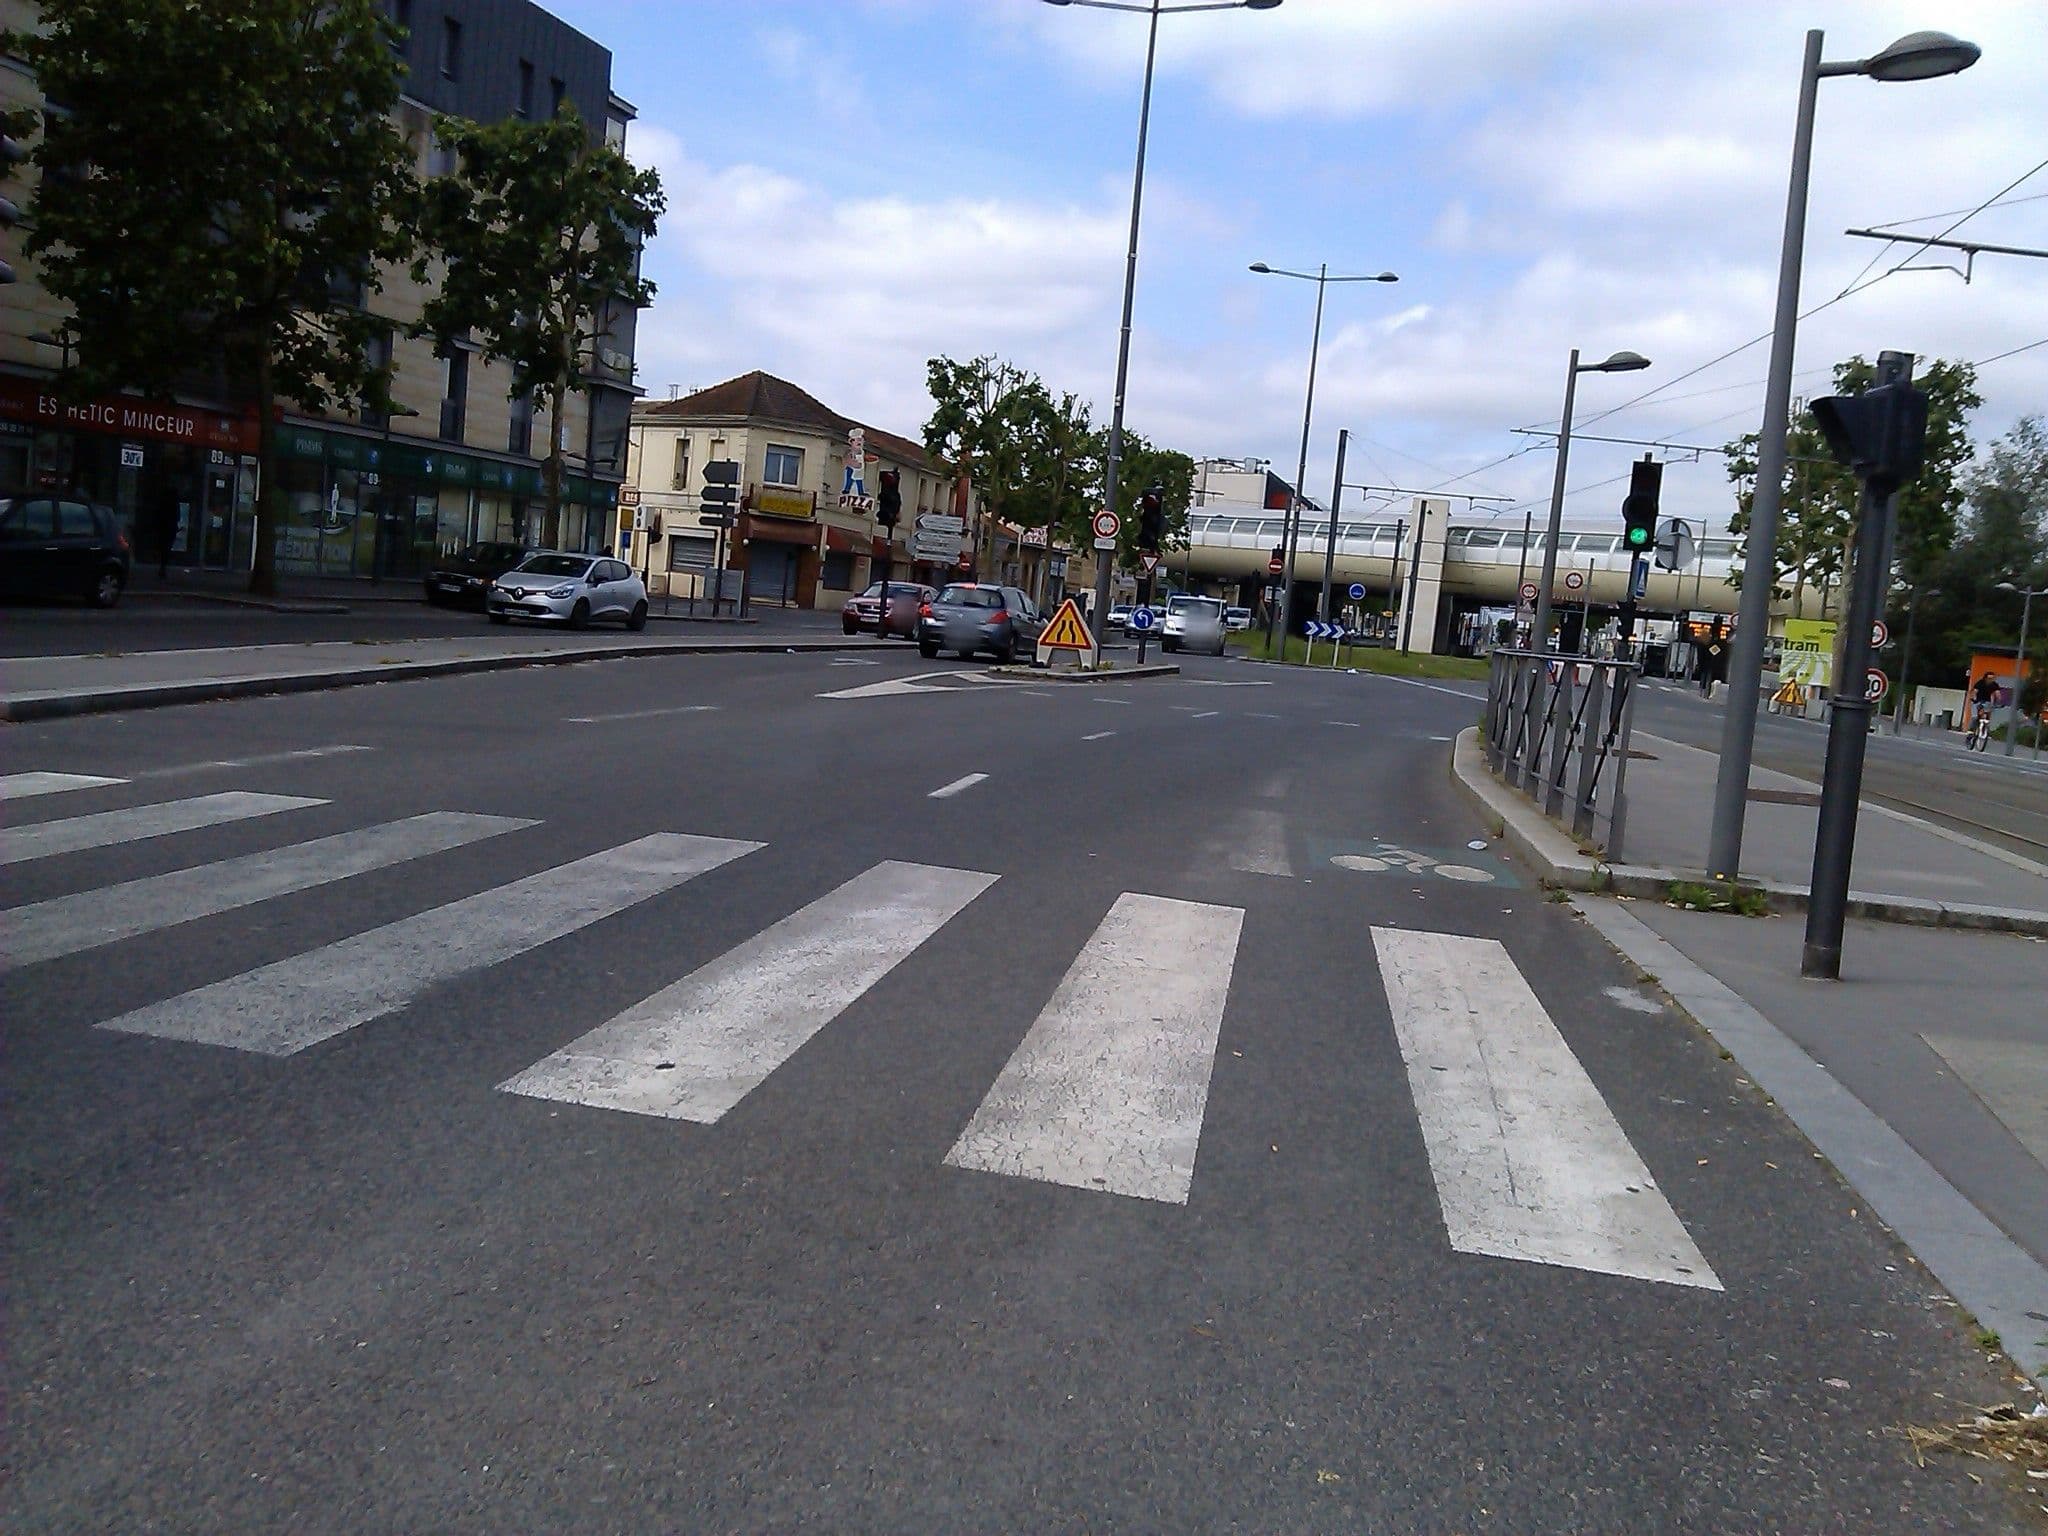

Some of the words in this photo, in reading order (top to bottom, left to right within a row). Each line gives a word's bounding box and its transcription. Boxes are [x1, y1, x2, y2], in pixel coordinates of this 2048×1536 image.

[38, 395, 116, 425] ESHETIC
[123, 408, 194, 436] MINCEUR
[210, 449, 224, 464] 89
[839, 495, 874, 511] PIZZA
[1783, 637, 1820, 653] tram
